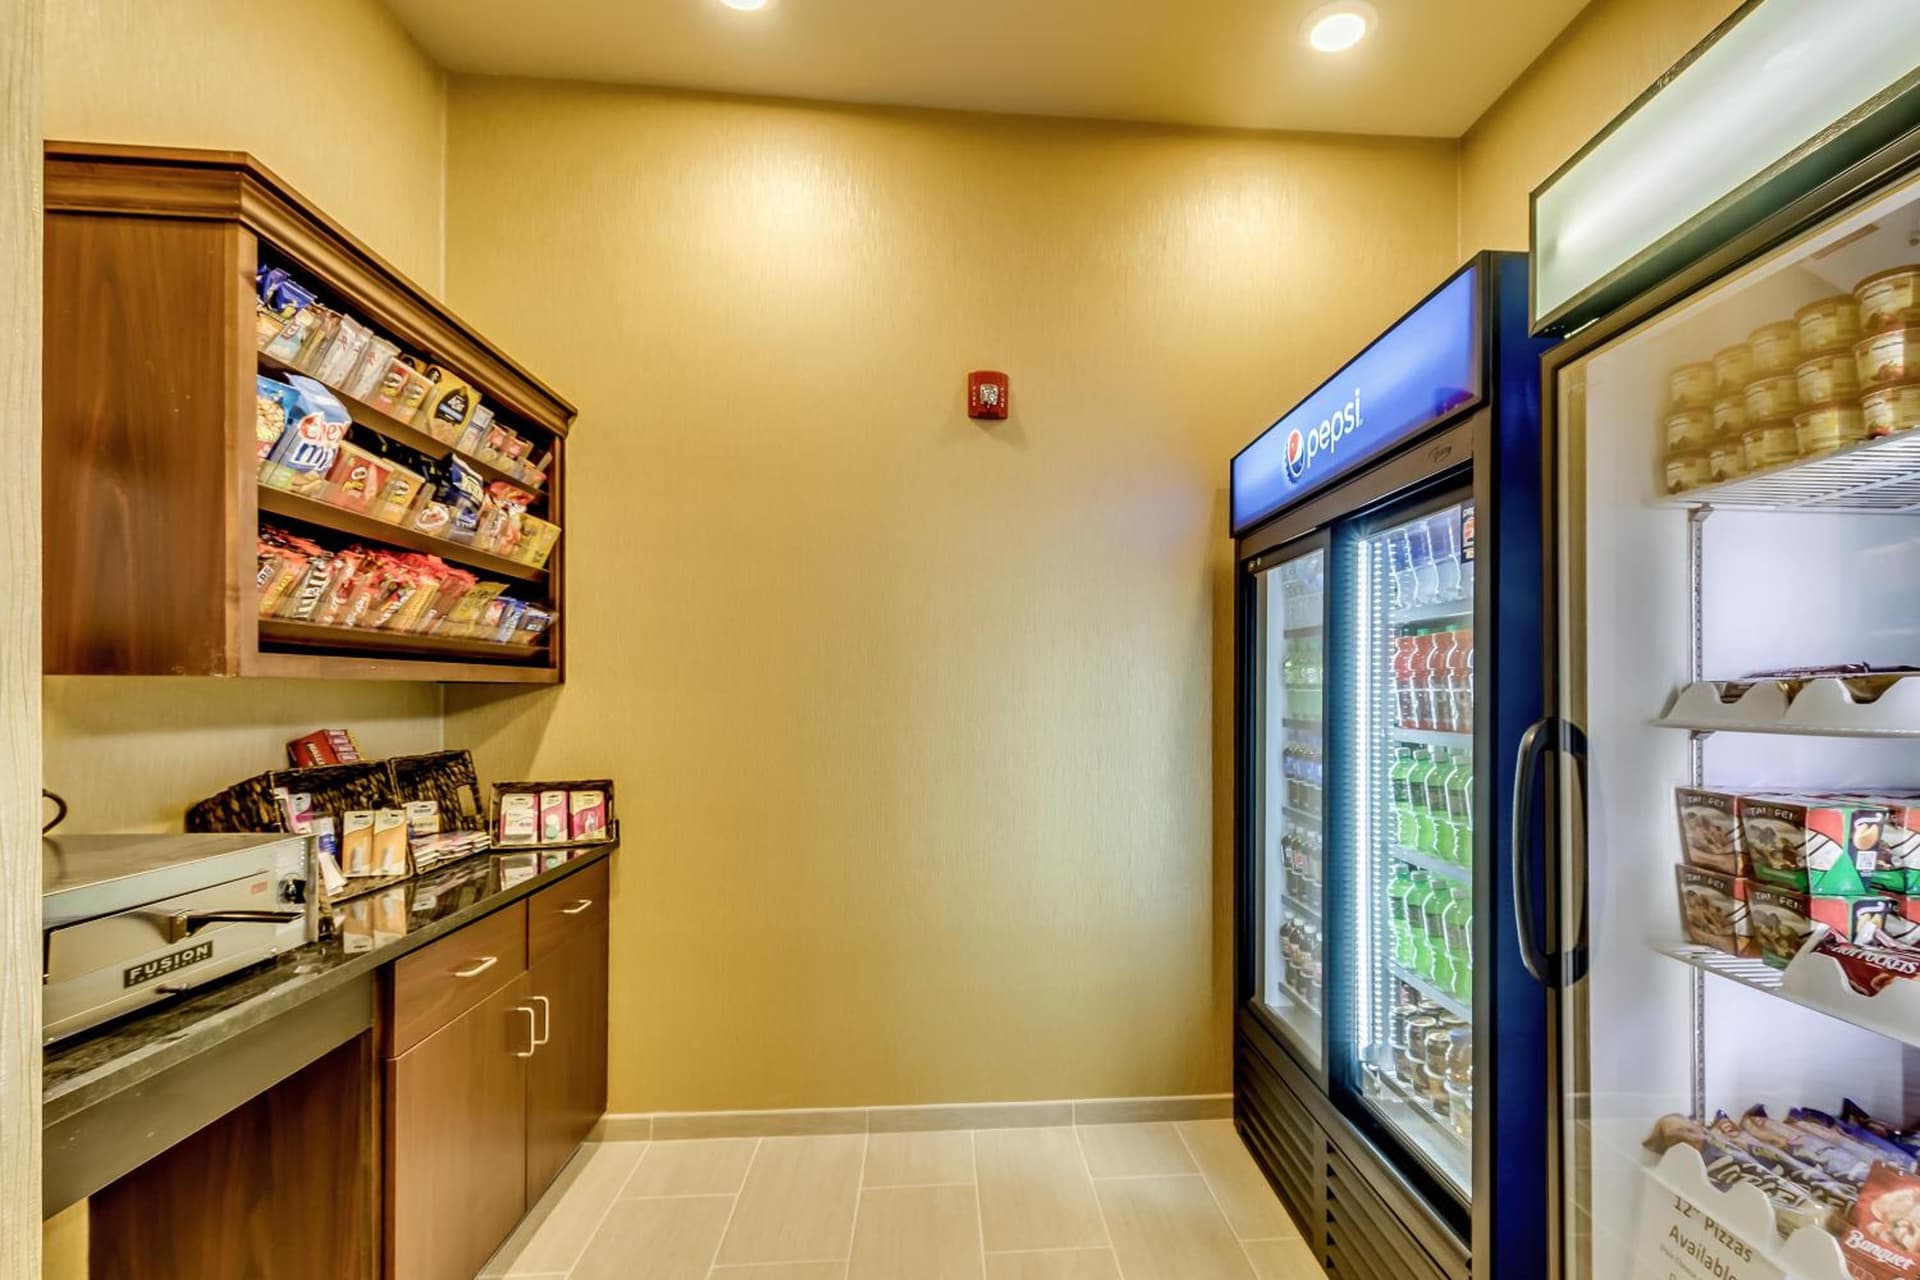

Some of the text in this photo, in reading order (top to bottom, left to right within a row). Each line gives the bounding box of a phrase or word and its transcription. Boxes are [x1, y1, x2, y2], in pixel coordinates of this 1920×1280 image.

[1306, 388, 1360, 467] pepsi
[129, 944, 209, 980] FUSION
[1857, 949, 1920, 975] POCKETS
[1704, 1216, 1754, 1263] Pizzas
[1844, 1229, 1917, 1272] Banquet
